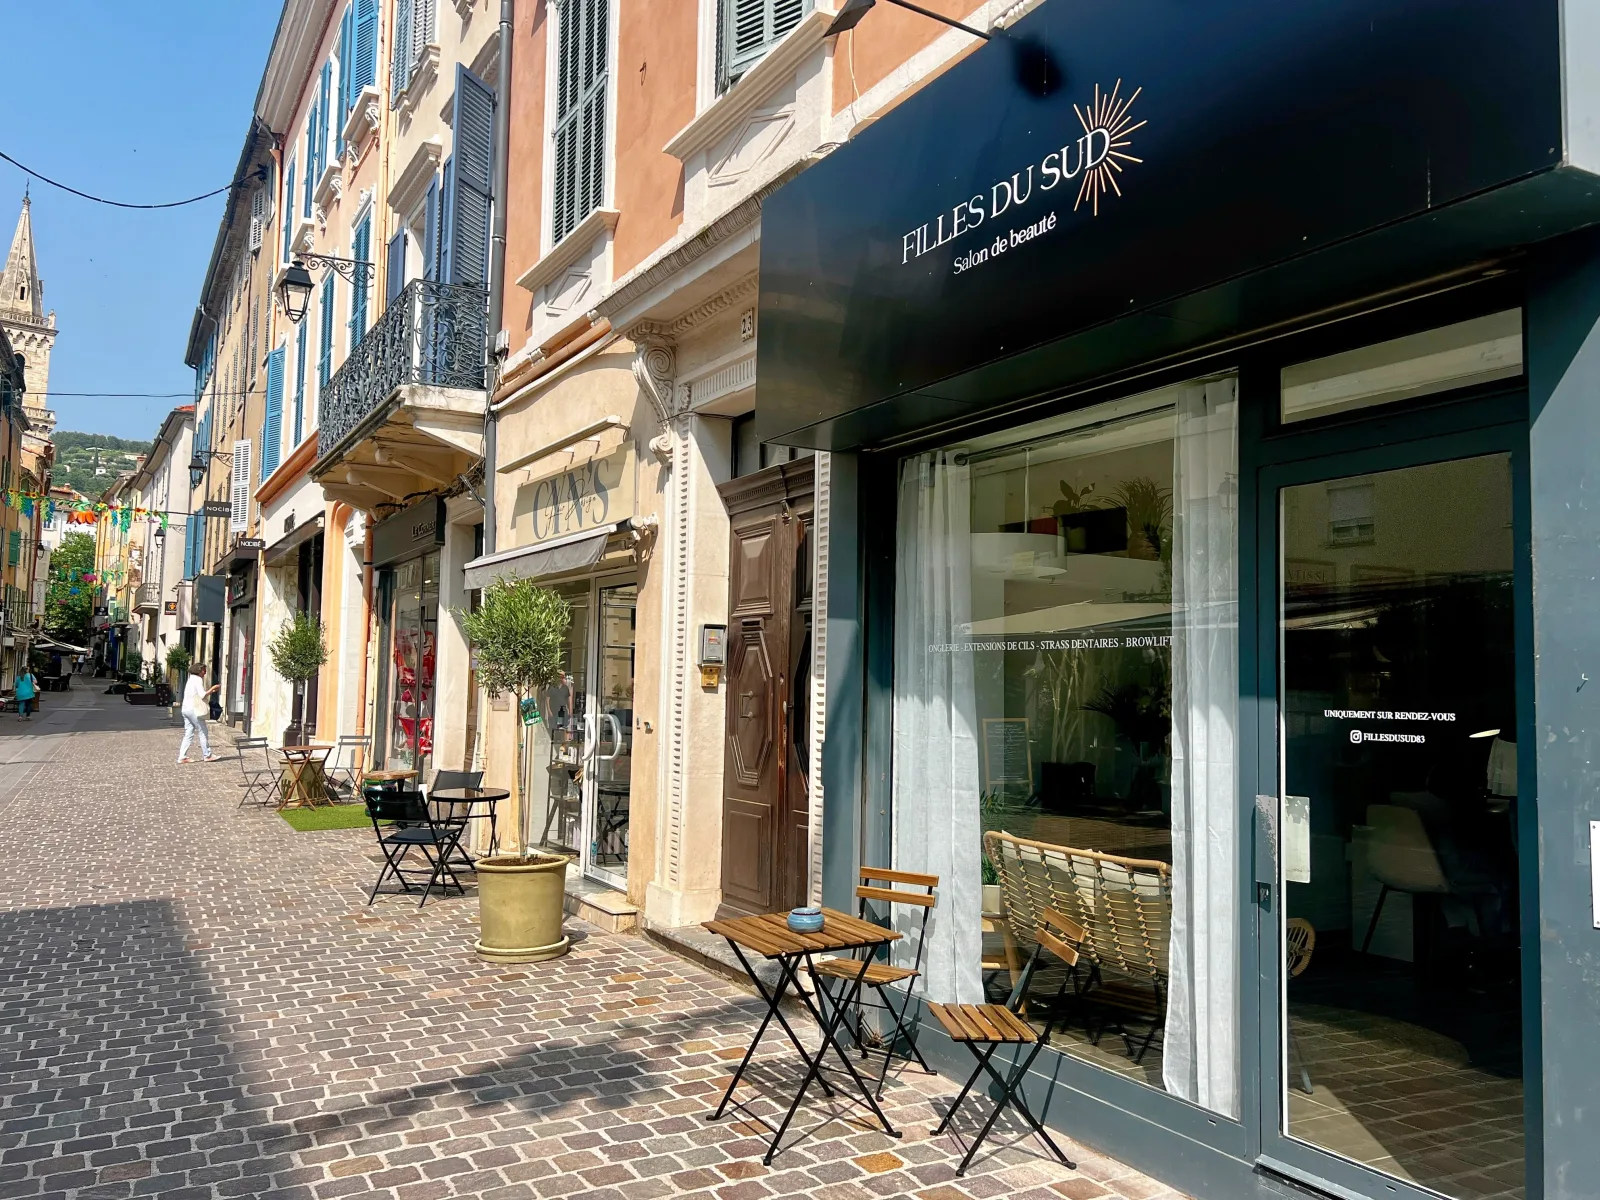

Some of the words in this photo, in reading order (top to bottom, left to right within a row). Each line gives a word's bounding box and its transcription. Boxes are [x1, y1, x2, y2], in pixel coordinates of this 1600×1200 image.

[901, 195, 985, 265] FILLES
[990, 165, 1034, 218] DU
[1040, 128, 1111, 190] SUD
[953, 246, 989, 275] Salon
[991, 236, 1008, 256] de
[1009, 211, 1057, 248] beauté
[928, 643, 960, 653] ONGLERIE
[964, 641, 1006, 652] EXTENSIONS
[1007, 641, 1018, 651] DE
[1018, 640, 1035, 651] CILS
[1040, 639, 1071, 650] STRASS
[1071, 637, 1119, 649] DENTAIRES
[1126, 636, 1174, 648] BROWLIFT
[1324, 709, 1376, 720] UNIQUEMENT
[1377, 711, 1394, 720] SUR
[1394, 711, 1456, 721] RENDEZ-VOUS
[1363, 732, 1426, 743] FILLESDUSUD83
